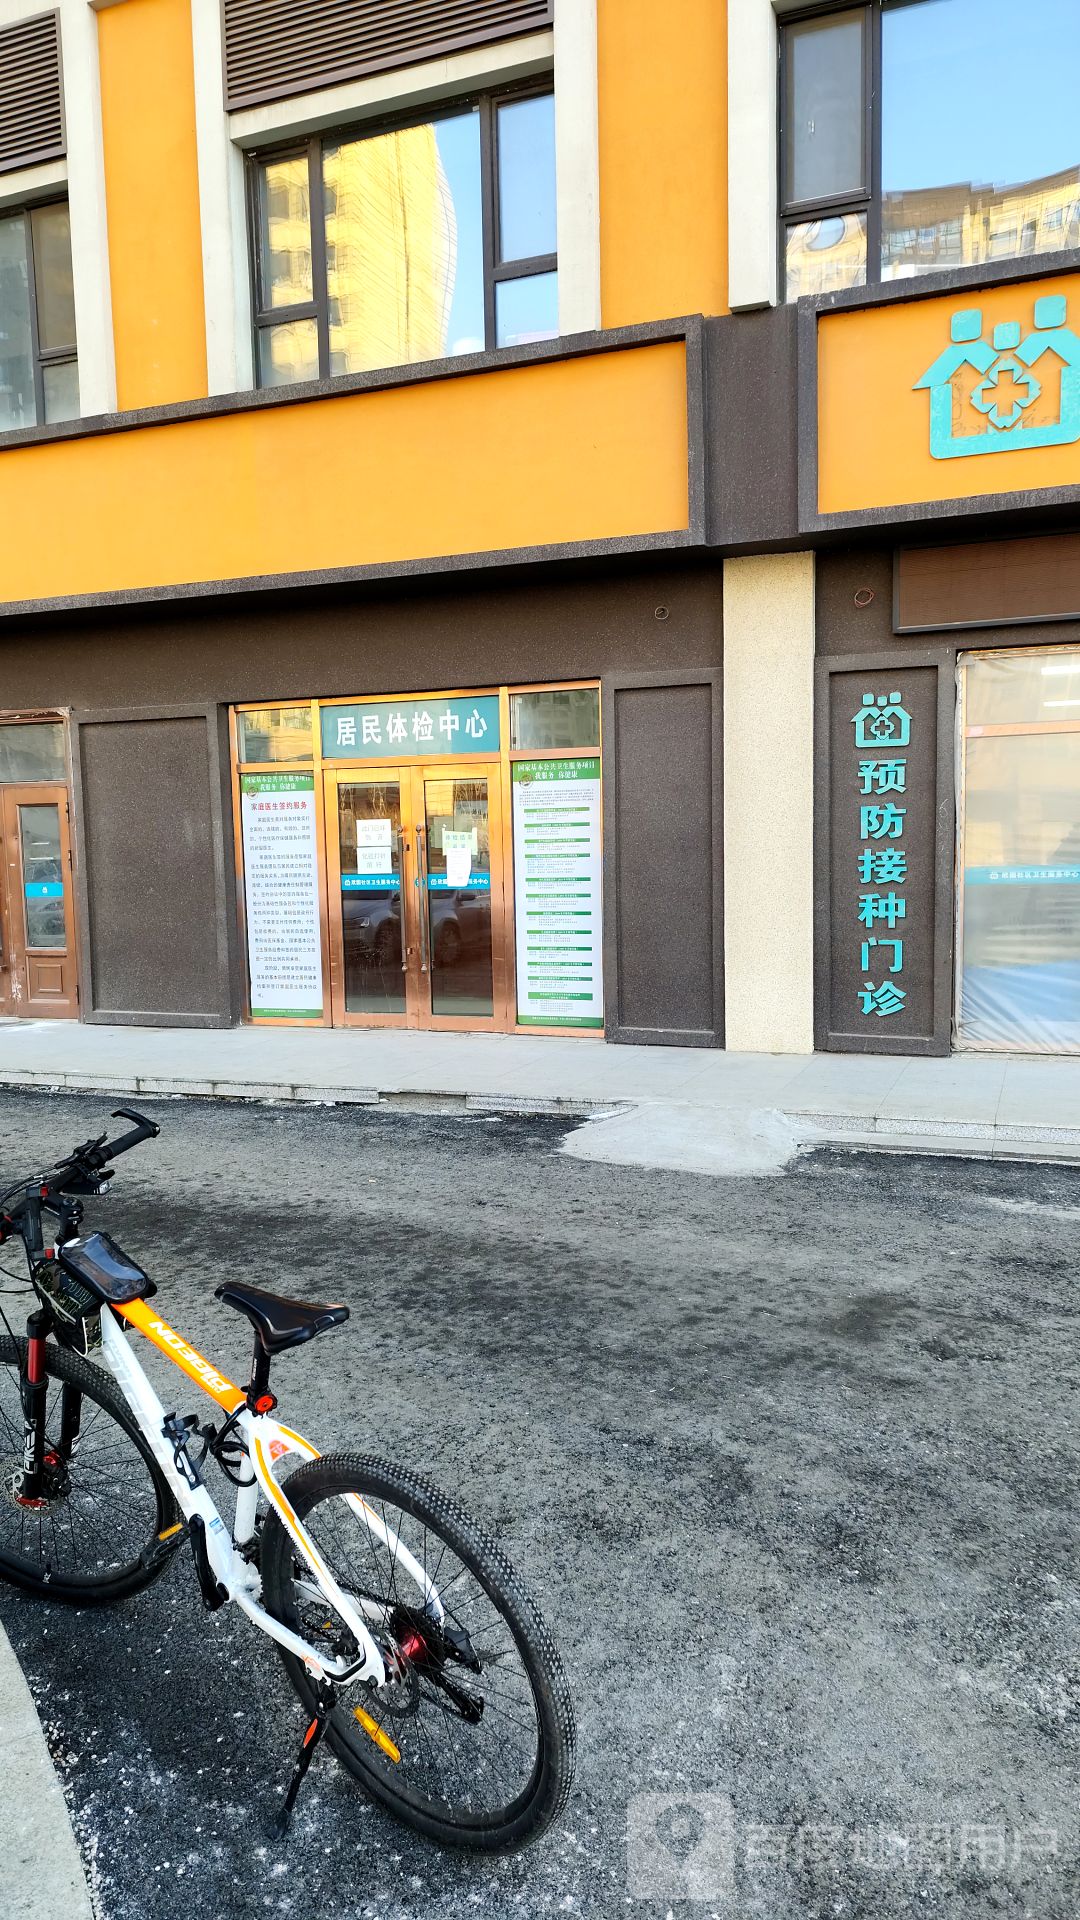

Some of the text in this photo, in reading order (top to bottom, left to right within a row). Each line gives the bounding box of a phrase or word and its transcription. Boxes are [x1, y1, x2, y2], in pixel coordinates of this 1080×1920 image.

[335, 708, 488, 746] 居民体检中心
[517, 760, 596, 772] 国家基本公共卫生服务项目
[250, 801, 308, 811] 家庭医生签约服务
[857, 758, 907, 1018] 预防接种门诊
[148, 1321, 234, 1392] PIGEON
